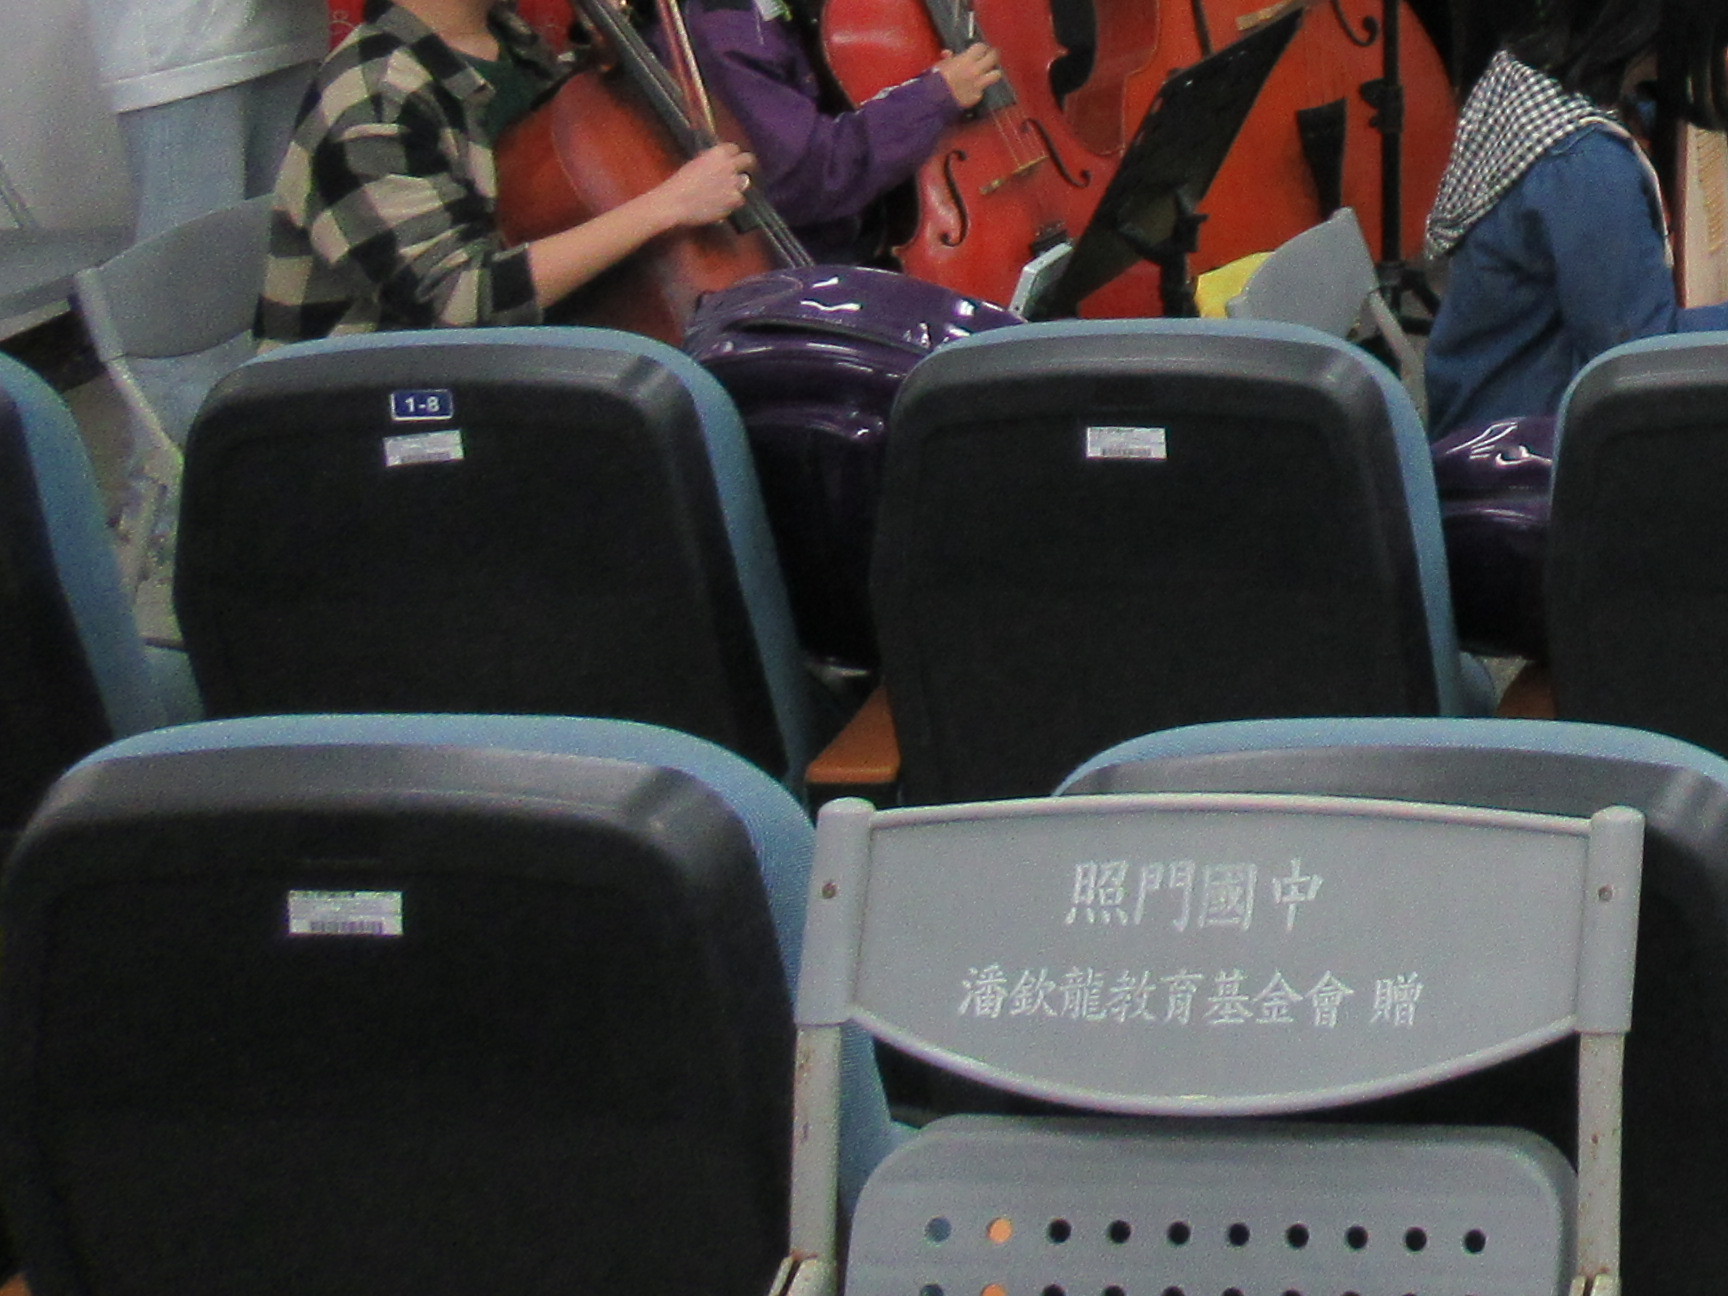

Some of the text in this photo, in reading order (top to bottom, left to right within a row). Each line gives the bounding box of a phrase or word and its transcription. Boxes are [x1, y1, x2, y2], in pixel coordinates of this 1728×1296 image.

[404, 395, 441, 413] 1-8
[1063, 857, 1325, 934] 照門國中
[1369, 970, 1425, 1028] 贈
